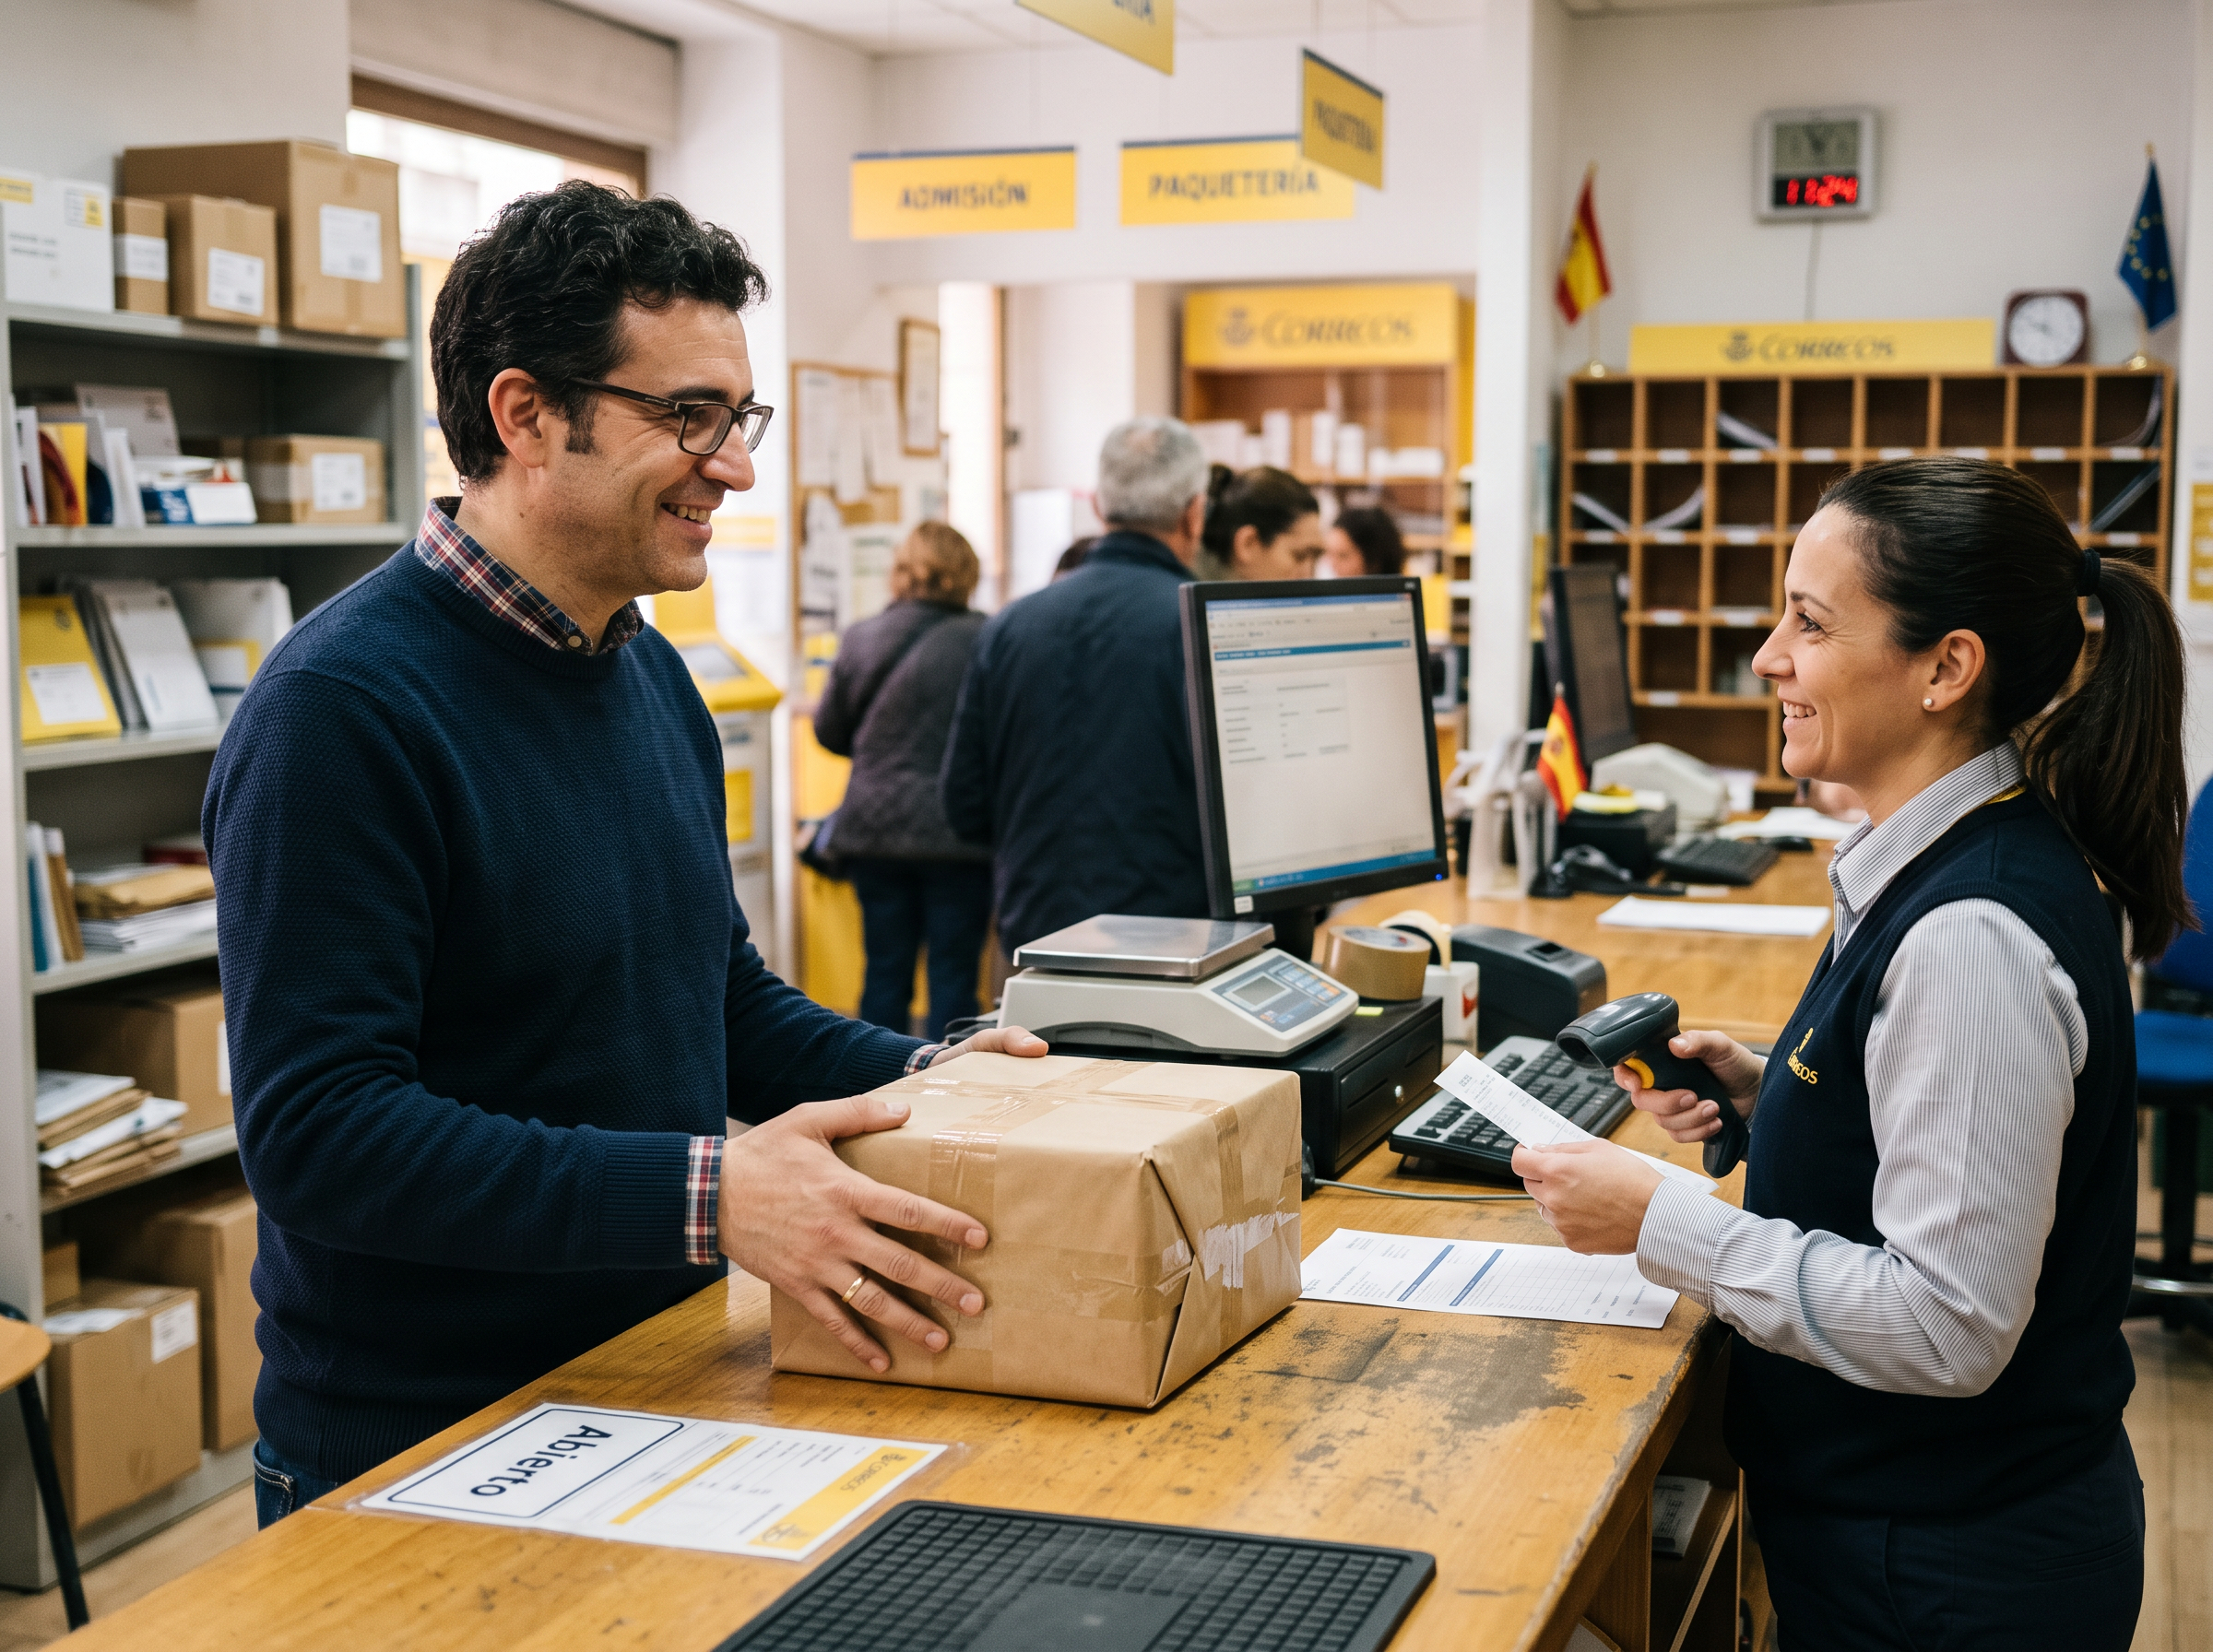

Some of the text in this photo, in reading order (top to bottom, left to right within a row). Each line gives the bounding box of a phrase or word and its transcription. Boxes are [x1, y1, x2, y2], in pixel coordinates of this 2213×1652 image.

[897, 175, 1031, 210] ADMISIÓN
[1261, 309, 1417, 348] CORREOS
[1759, 331, 1896, 362] CORREOS
[470, 1424, 612, 1496] Abierto
